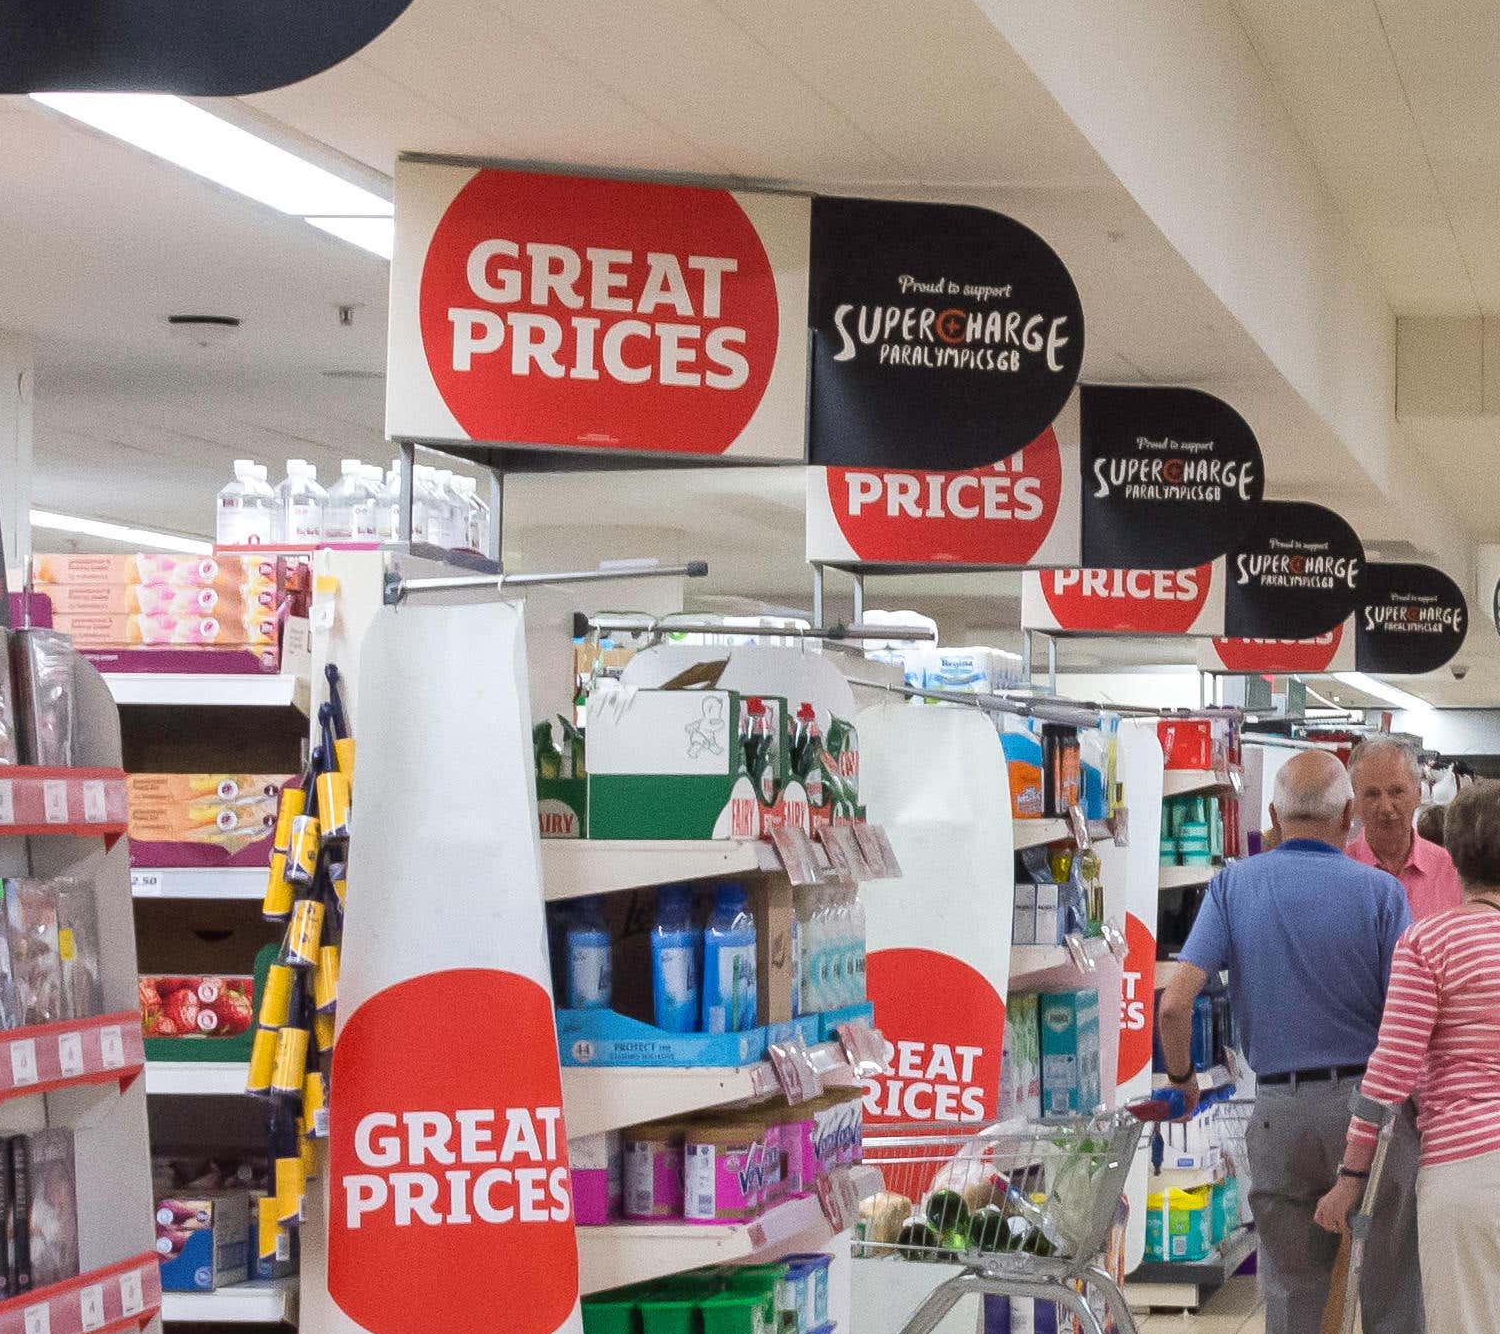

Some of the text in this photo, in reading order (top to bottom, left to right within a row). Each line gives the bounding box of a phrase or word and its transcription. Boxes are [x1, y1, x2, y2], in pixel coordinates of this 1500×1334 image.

[466, 239, 738, 319] GREAT
[899, 275, 1012, 301] Proud to support
[447, 309, 750, 390] PRICES
[834, 304, 1069, 371] SUPERCHARGE
[1136, 435, 1214, 454] Proud to support
[845, 471, 1045, 521] PRICES
[1093, 457, 1255, 501] SUPERCHARGE
[1052, 567, 1199, 601] PRICES
[1236, 553, 1359, 589] SUPERCHARGE
[1364, 602, 1463, 631] SUPERCHARGE
[940, 657, 975, 670] Regina
[862, 1082, 985, 1123] RICES
[354, 1106, 565, 1166] GREAT
[342, 1163, 571, 1229] PRICES
